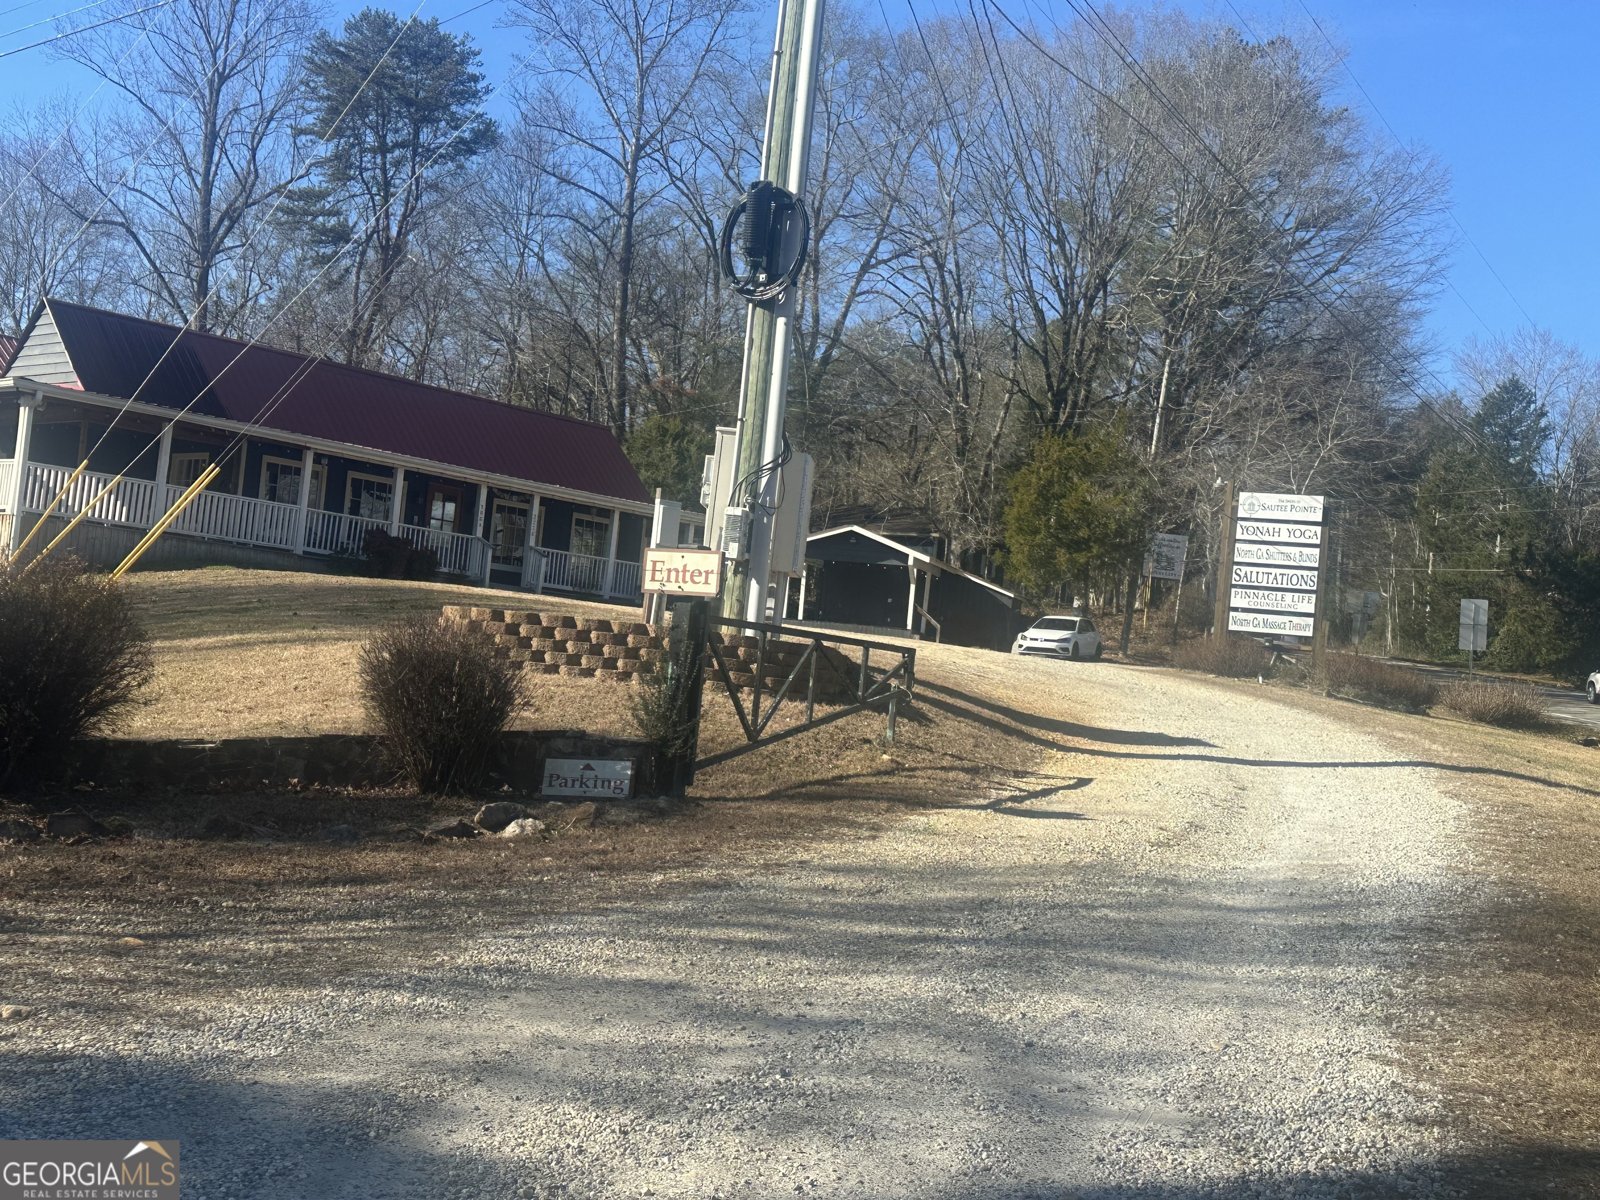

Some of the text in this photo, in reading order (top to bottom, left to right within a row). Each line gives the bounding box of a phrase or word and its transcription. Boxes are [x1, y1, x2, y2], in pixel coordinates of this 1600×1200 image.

[1261, 503, 1317, 514] SAUTEE POINTE
[1240, 525, 1319, 540] YONAH YOGA
[649, 559, 715, 586] Enter
[1234, 568, 1316, 588] SALUTATIONS
[1247, 600, 1299, 610] COUNSELING
[1291, 594, 1314, 605] LIFE
[1231, 615, 1251, 627] NORTH
[1252, 616, 1261, 628] GA
[1288, 620, 1312, 632] THERAPY
[544, 773, 625, 795] Parking
